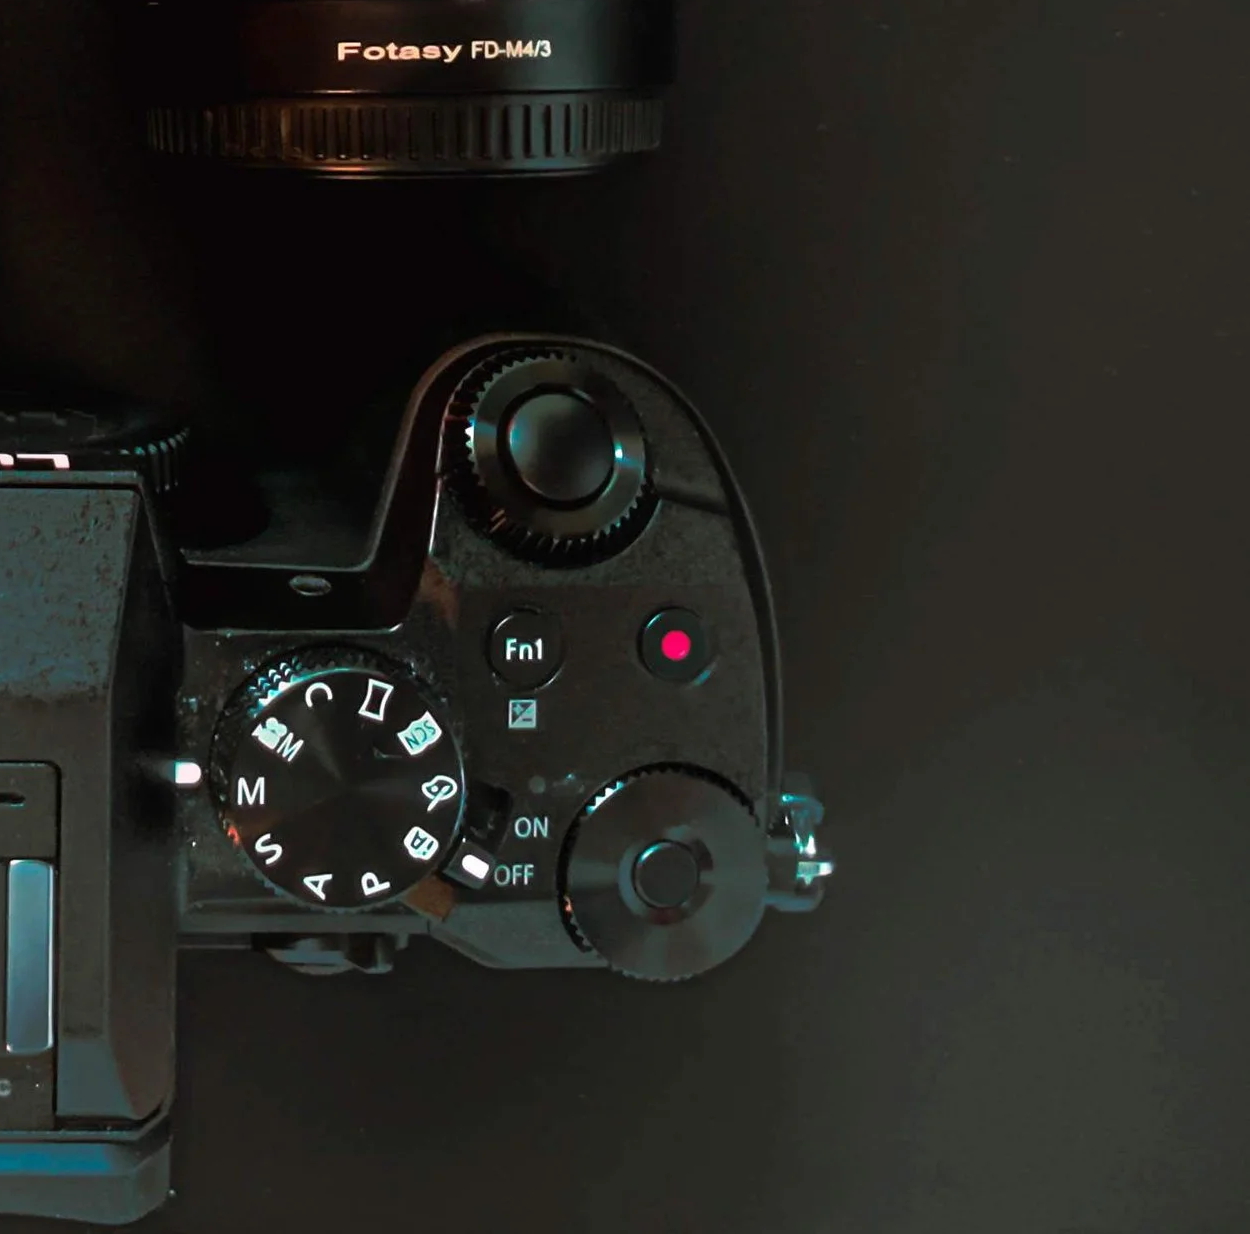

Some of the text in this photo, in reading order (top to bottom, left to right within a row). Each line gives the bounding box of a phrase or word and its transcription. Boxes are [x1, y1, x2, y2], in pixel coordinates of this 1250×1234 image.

[337, 39, 552, 63] Fotasy FD-M4/3
[505, 638, 543, 661] Fn1
[305, 682, 333, 708] C
[405, 719, 437, 750] SCN
[237, 776, 265, 806] M
[515, 817, 549, 839] ON
[255, 833, 283, 865] S
[303, 873, 333, 901] A
[361, 871, 391, 897] P
[494, 863, 535, 887] OFF
